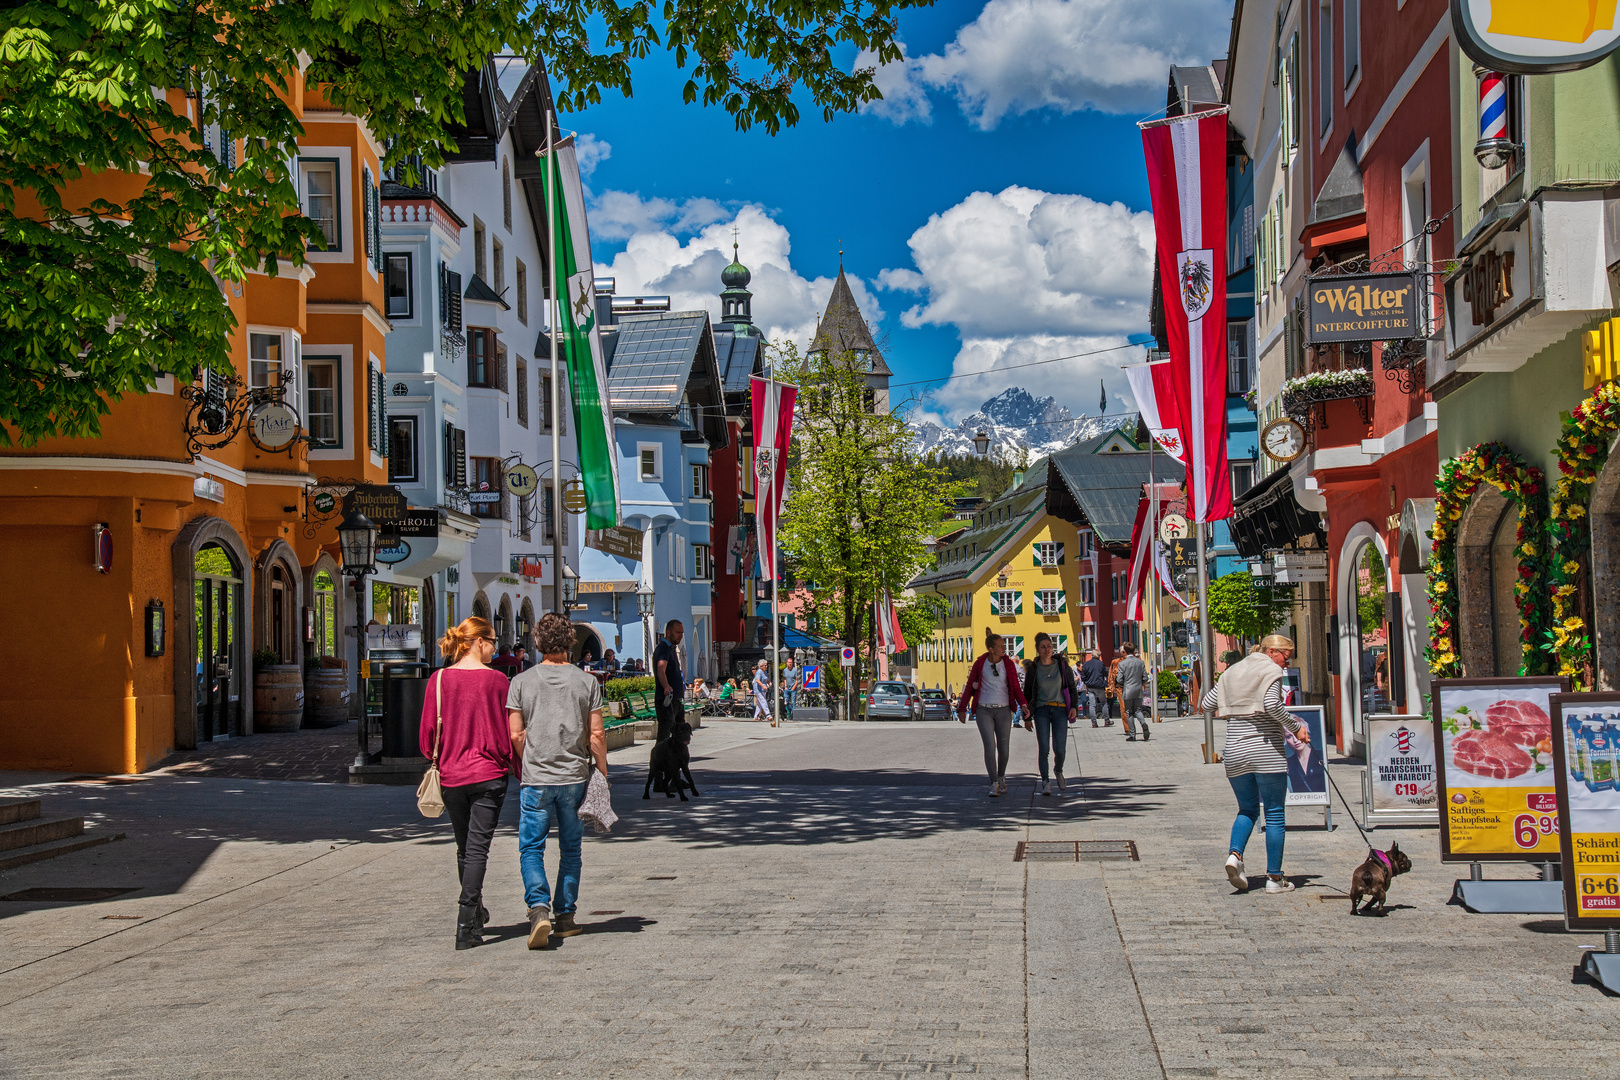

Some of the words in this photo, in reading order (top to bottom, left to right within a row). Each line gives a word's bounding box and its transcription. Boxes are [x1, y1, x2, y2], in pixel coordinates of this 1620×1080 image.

[1314, 285, 1408, 317] Walter
[1315, 318, 1409, 333] INTERCOIFFURE
[256, 415, 292, 438] Hair
[376, 538, 396, 547] haus
[578, 582, 614, 593] ENTRO
[377, 625, 413, 648] Hair
[1390, 757, 1420, 765] HERREN
[1379, 765, 1432, 773] HAARSCHNITT
[1398, 773, 1432, 781] HAIRCUT
[1395, 783, 1418, 796] €19
[1450, 806, 1486, 816] Saftiges
[1450, 815, 1501, 825] Schopfsteak
[1582, 877, 1619, 895] 6+6
[1587, 897, 1617, 908] gratis
